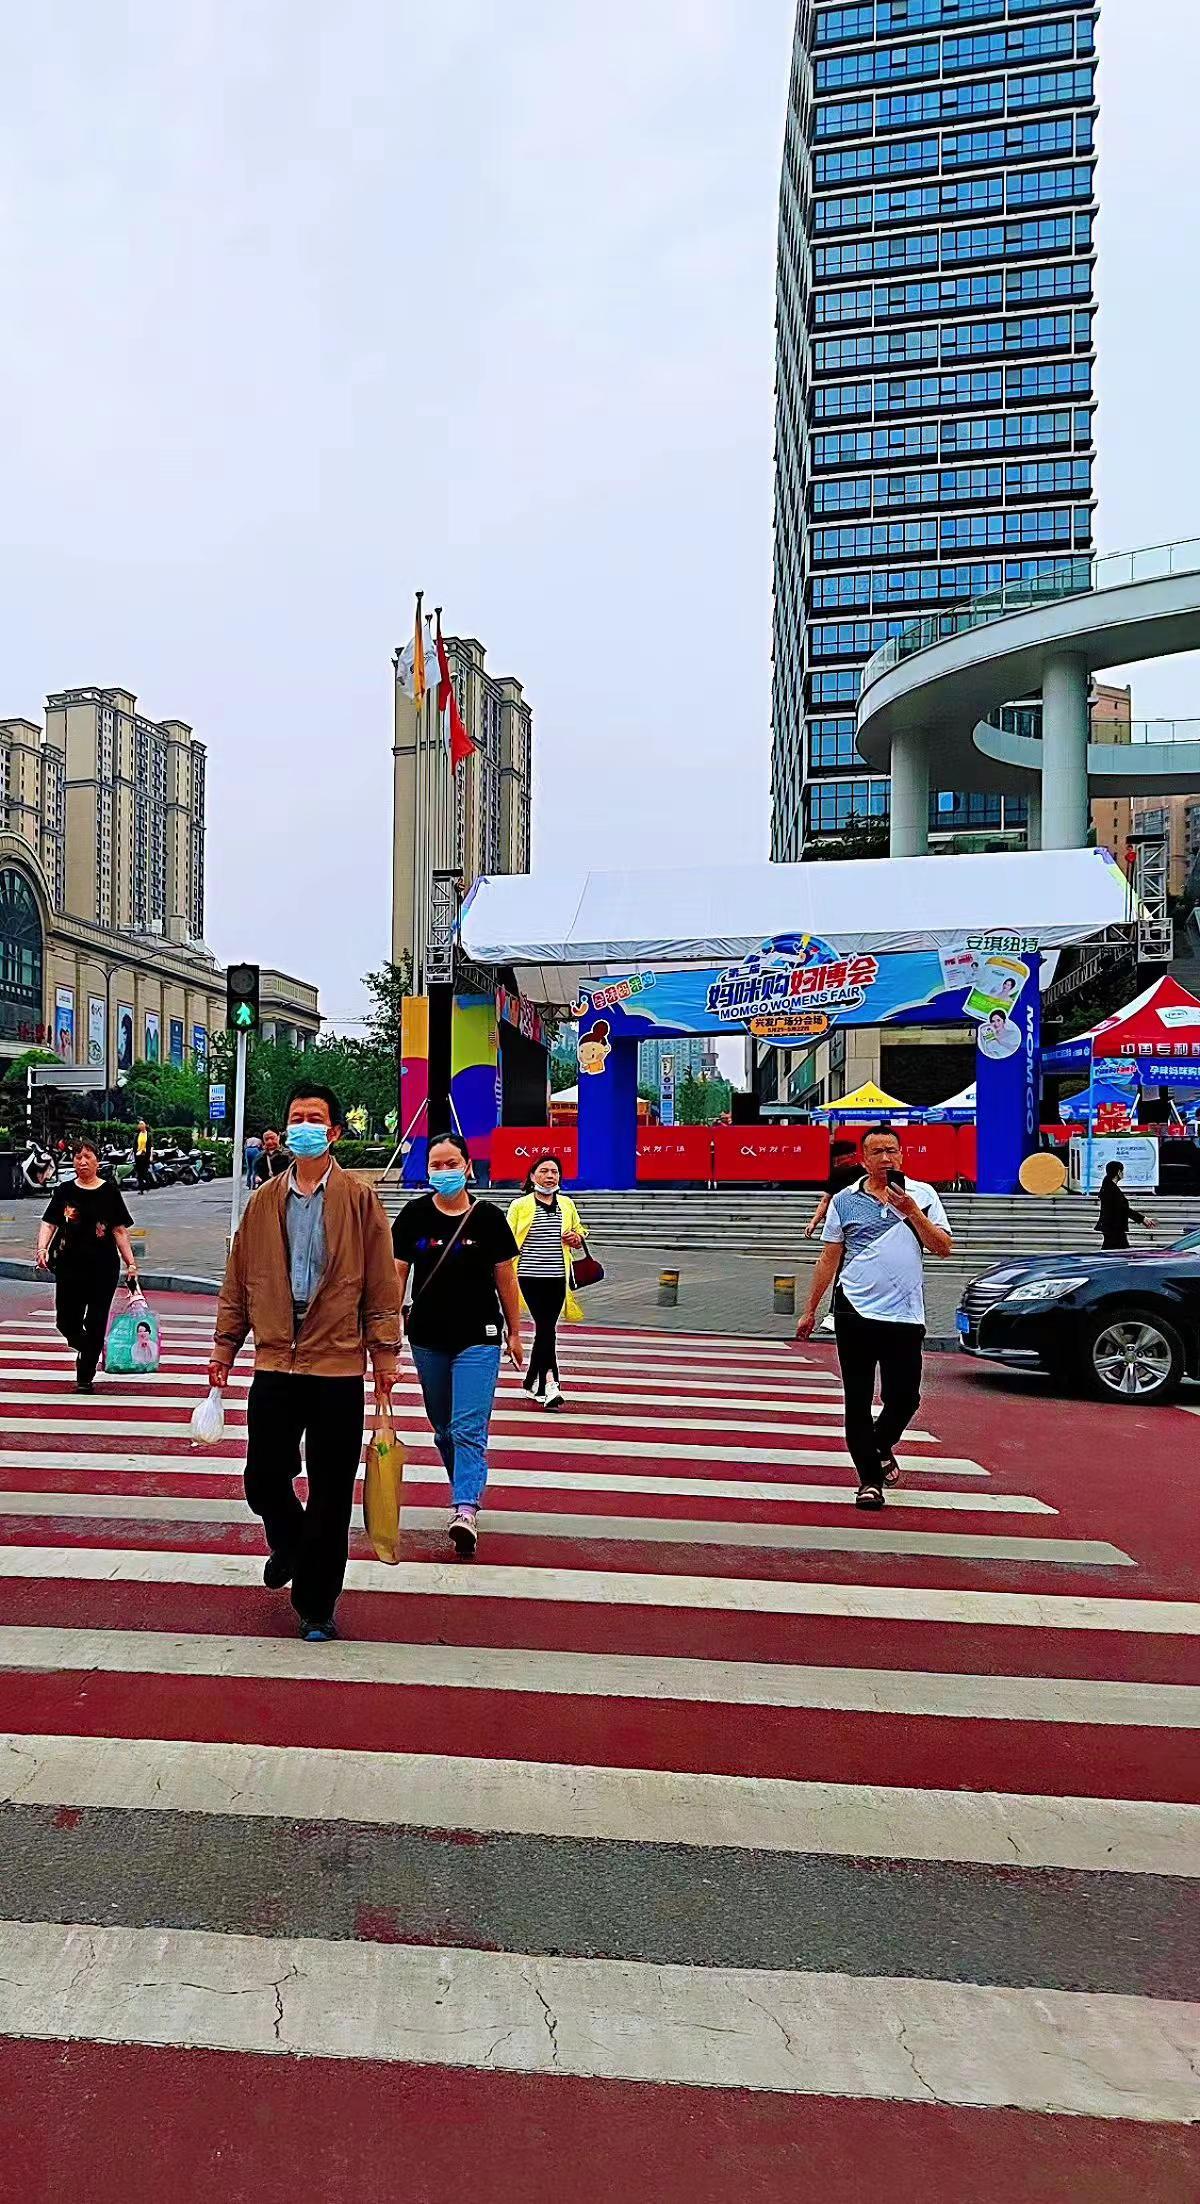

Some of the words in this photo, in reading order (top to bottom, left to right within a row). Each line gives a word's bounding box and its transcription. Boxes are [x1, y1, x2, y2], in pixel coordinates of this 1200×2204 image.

[965, 935, 1039, 953] 安琪纽特
[720, 1003, 768, 1020] MOMGO
[770, 991, 828, 1013] WOMENS
[831, 986, 860, 1001] FAIR
[755, 1015, 823, 1029] 兴发广场分会场
[1026, 1004, 1034, 1135] MOMGO
[1149, 1065, 1200, 1075] 孕味妈咪购
